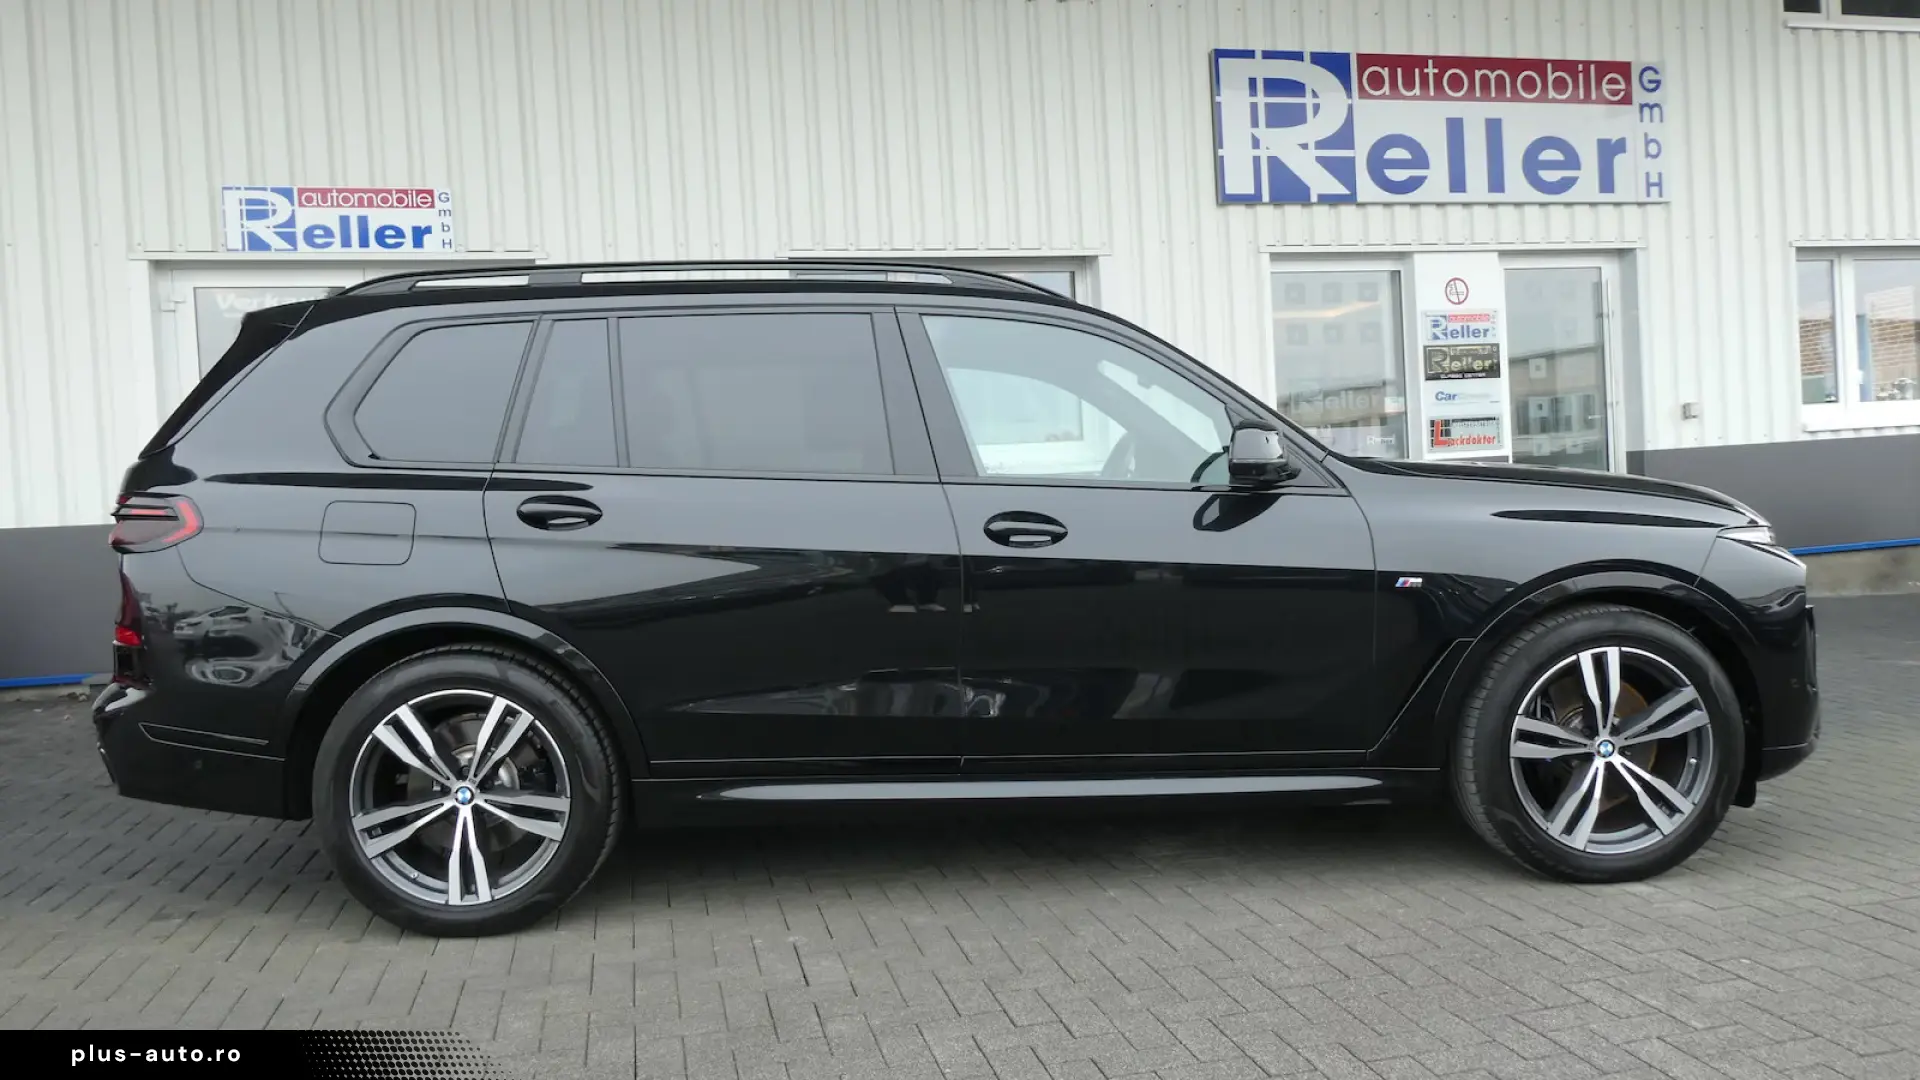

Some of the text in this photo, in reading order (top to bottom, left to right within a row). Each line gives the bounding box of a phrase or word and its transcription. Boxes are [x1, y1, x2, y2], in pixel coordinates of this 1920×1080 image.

[1361, 58, 1628, 101] automobile
[1215, 56, 1627, 196] Reller
[1637, 65, 1665, 199] GmbH
[223, 188, 433, 251] Reller
[301, 189, 433, 209] automobile
[437, 191, 453, 250] GmbH
[1426, 315, 1490, 341] Reller
[1427, 347, 1493, 374] Reller
